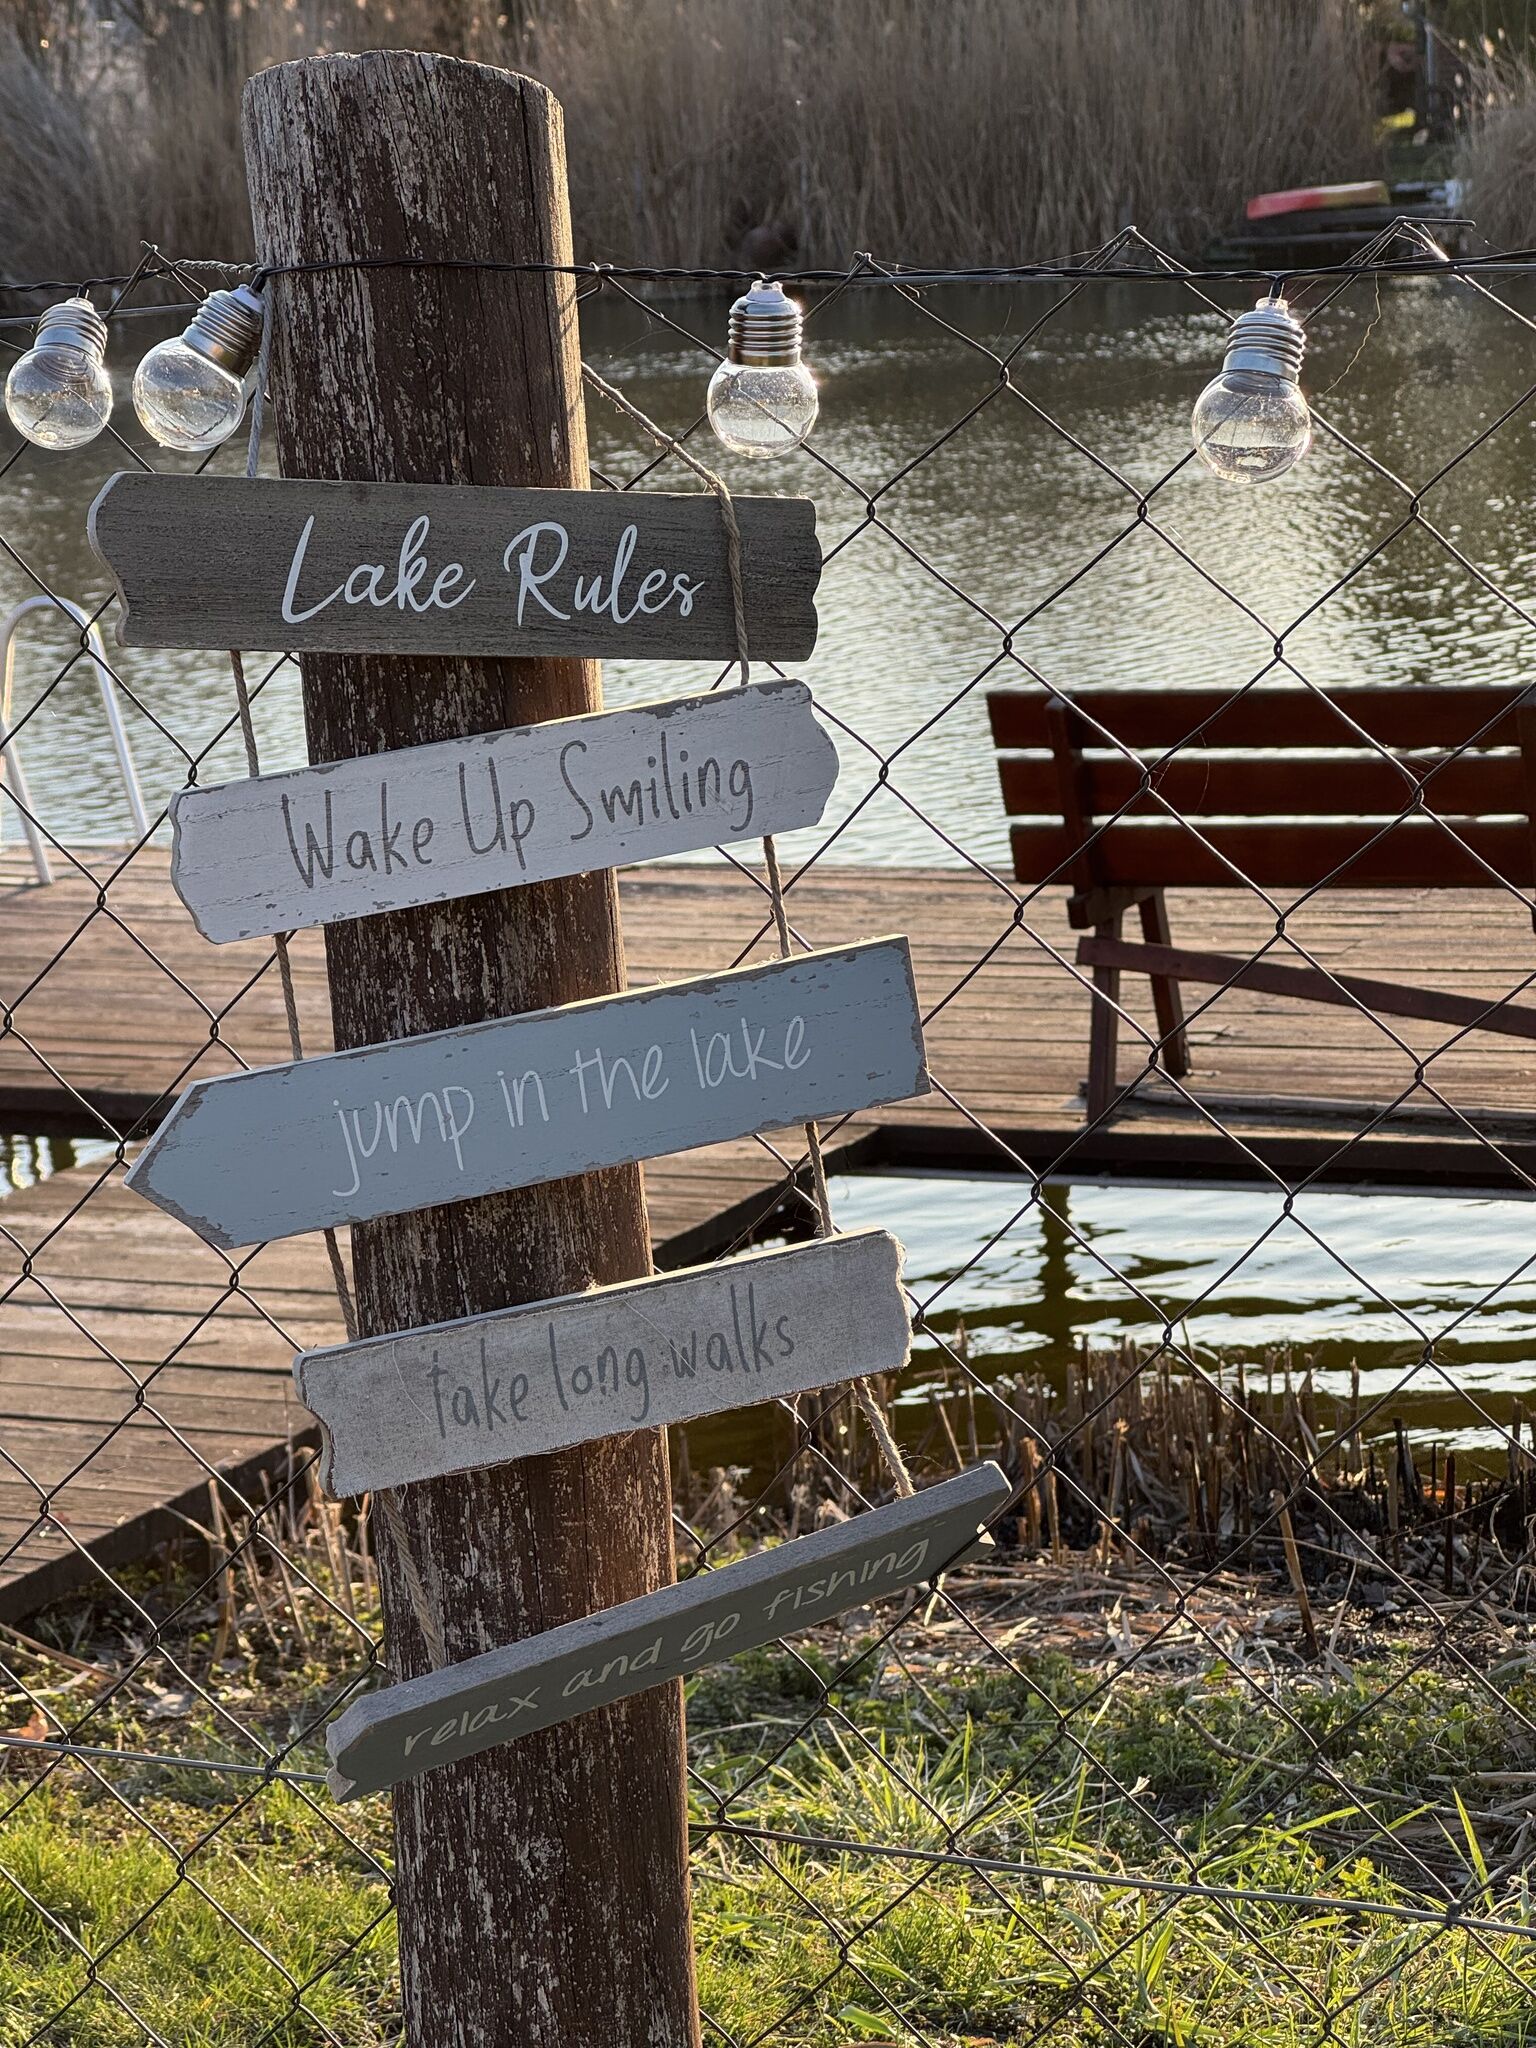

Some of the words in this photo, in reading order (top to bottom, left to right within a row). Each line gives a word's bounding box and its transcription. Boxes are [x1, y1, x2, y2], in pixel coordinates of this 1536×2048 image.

[281, 515, 475, 624] Lake
[504, 521, 704, 626] Rules
[281, 782, 434, 889] Wake
[459, 756, 534, 870] Up
[560, 731, 755, 841] Smiling
[332, 1085, 474, 1197] jump
[498, 1069, 549, 1127] in
[572, 1044, 669, 1114] the
[690, 1014, 811, 1089] lake
[426, 1337, 529, 1437] take
[549, 1323, 650, 1423] long
[669, 1282, 796, 1379] walks
[404, 1688, 538, 1756] relax
[562, 1637, 662, 1699] and
[680, 1612, 740, 1662] go
[762, 1537, 929, 1618] fishing
